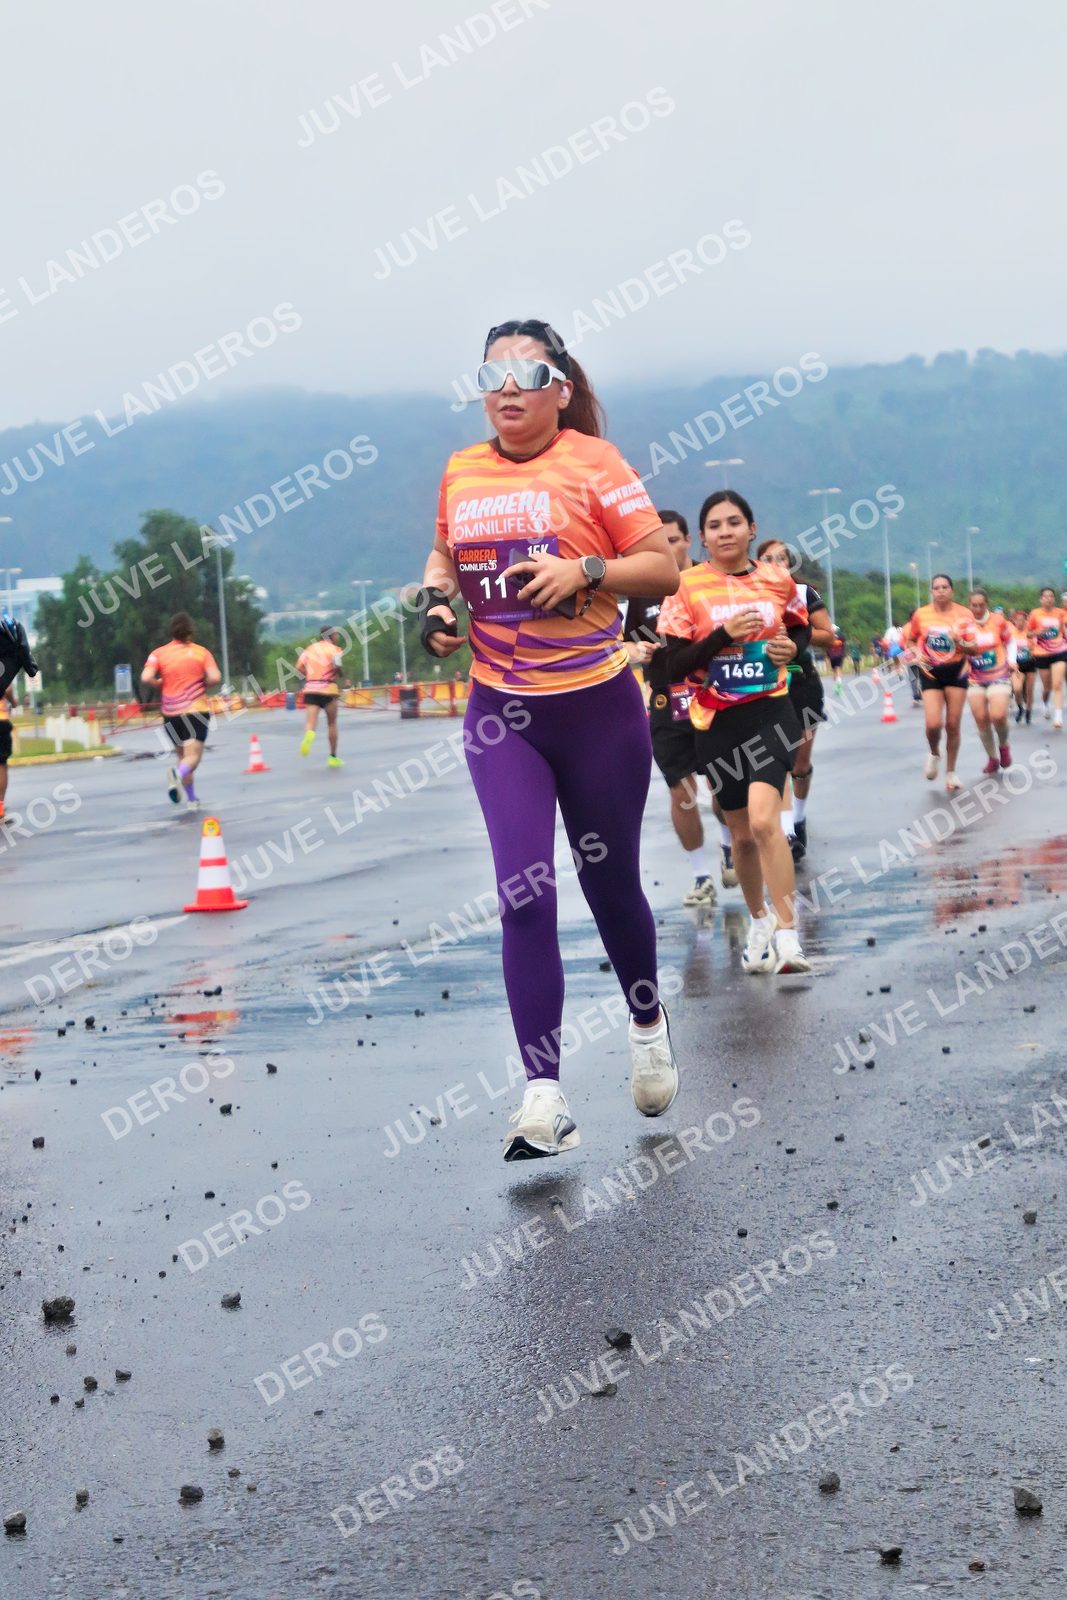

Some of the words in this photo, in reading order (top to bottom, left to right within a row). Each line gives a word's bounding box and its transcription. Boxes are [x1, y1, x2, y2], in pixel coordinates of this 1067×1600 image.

[454, 490, 550, 524] CARRERA
[453, 517, 526, 541] OMNILIFE
[458, 548, 497, 563] CARRERA
[459, 562, 488, 572] OMNILIFE
[721, 661, 764, 679] 1462
